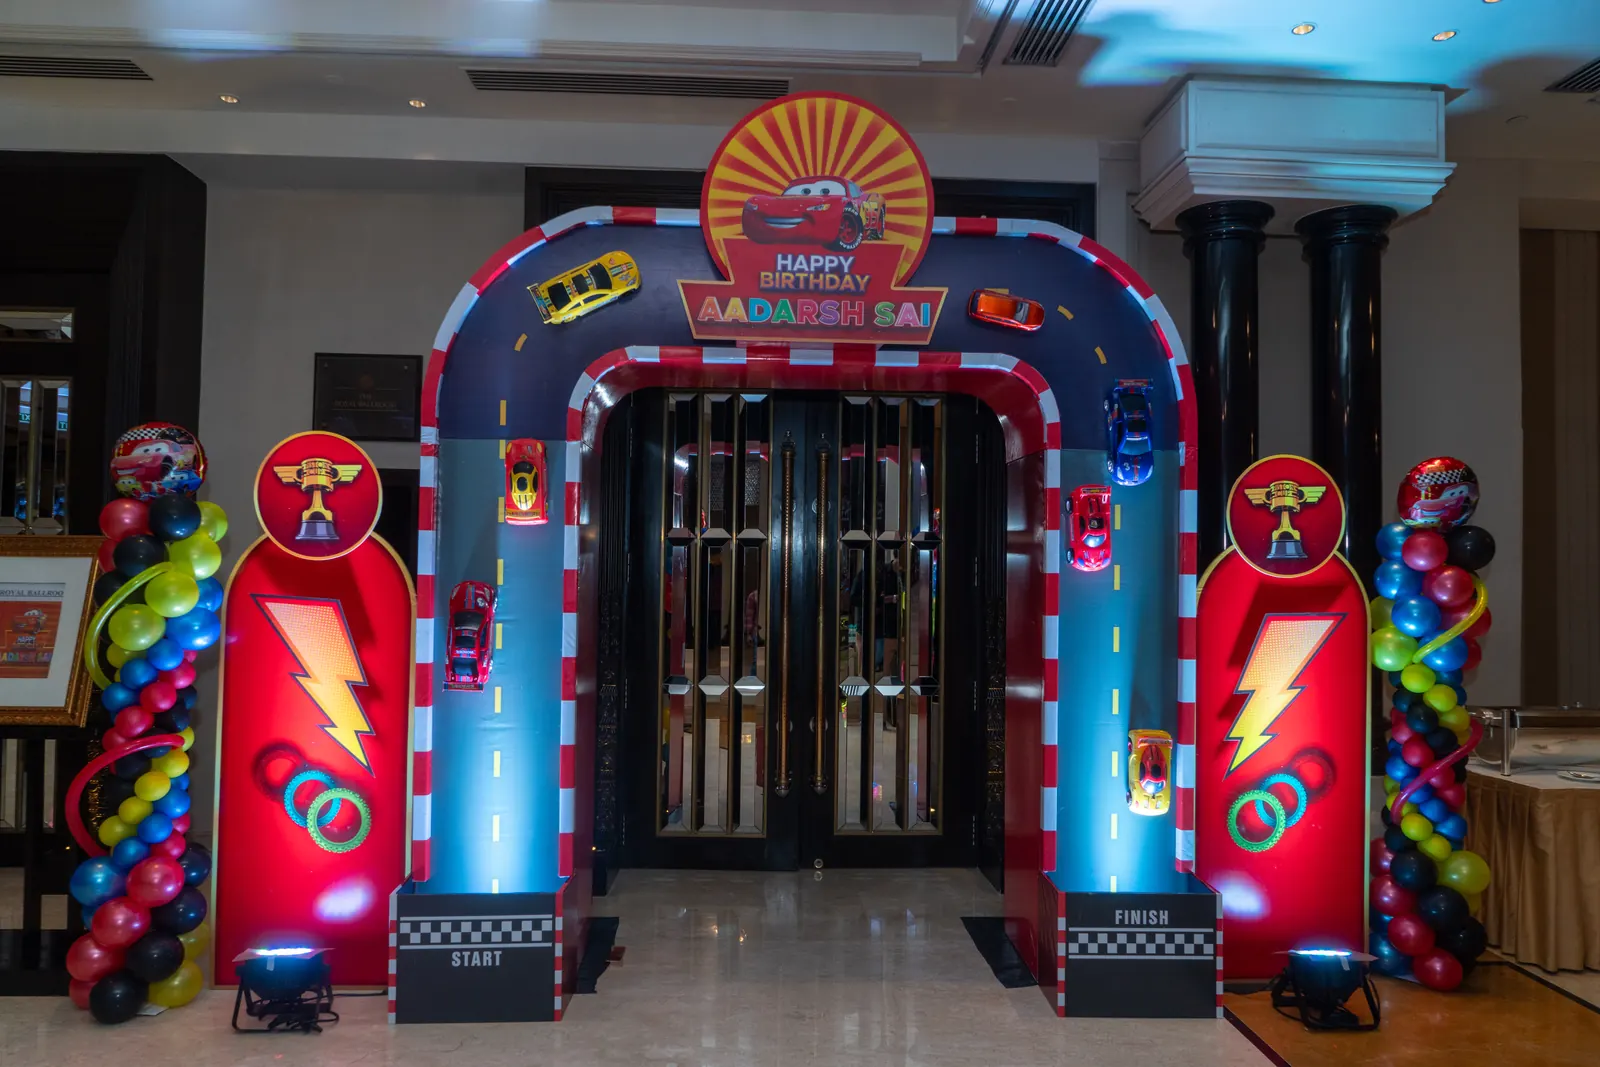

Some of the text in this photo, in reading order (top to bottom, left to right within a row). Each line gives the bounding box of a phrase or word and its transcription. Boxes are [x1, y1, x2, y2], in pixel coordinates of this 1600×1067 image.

[776, 254, 855, 273] HAPPY
[760, 272, 871, 292] BIRTHDAY
[697, 296, 931, 327] AADARSH SAI
[1115, 910, 1169, 925] FINISH
[451, 951, 502, 967] START
